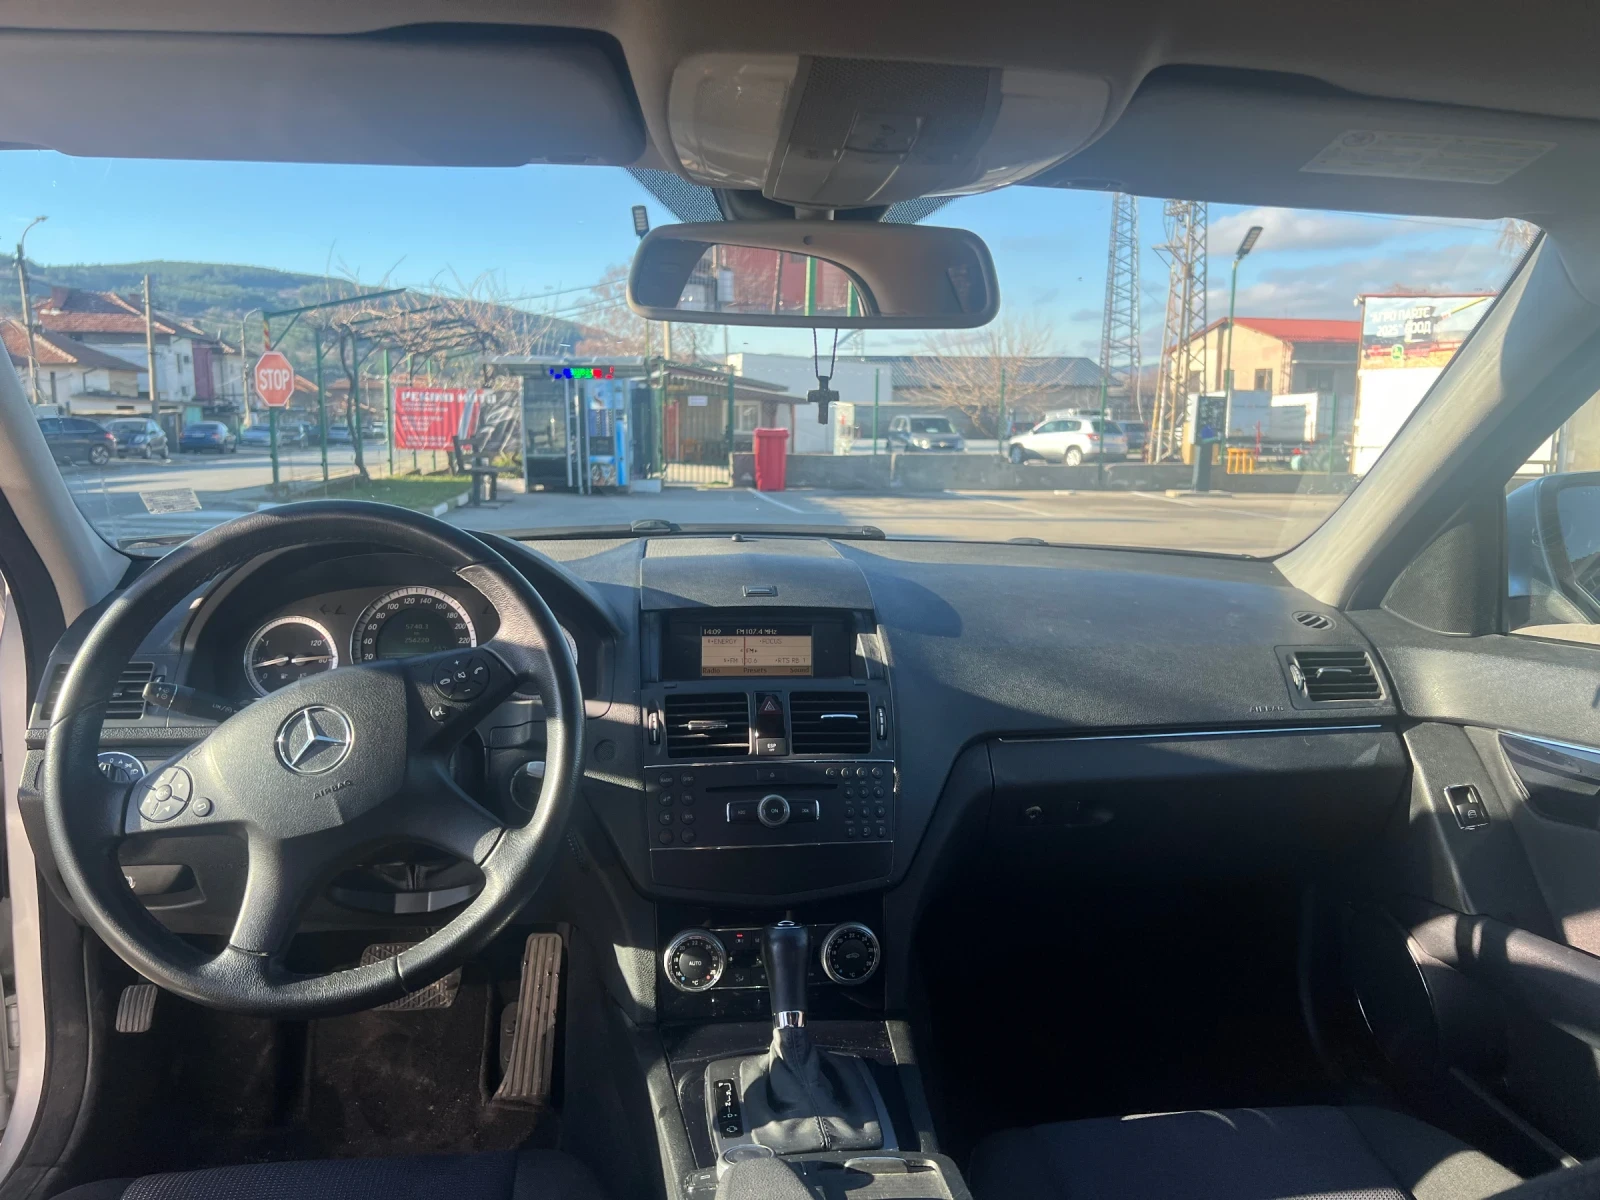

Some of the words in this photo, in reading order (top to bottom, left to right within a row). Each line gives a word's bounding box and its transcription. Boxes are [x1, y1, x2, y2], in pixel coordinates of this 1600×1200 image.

[259, 369, 290, 390] STOP
[403, 597, 416, 605] 120
[420, 597, 432, 605] 140
[387, 602, 400, 611] 100
[435, 602, 447, 610] 160
[375, 612, 386, 620] 80
[446, 612, 458, 620] 180
[367, 623, 378, 631] 60
[454, 622, 467, 631] 200
[363, 637, 373, 646] 40
[457, 637, 471, 645] 220
[363, 652, 374, 661] 20
[312, 779, 352, 800] AIRBAG
